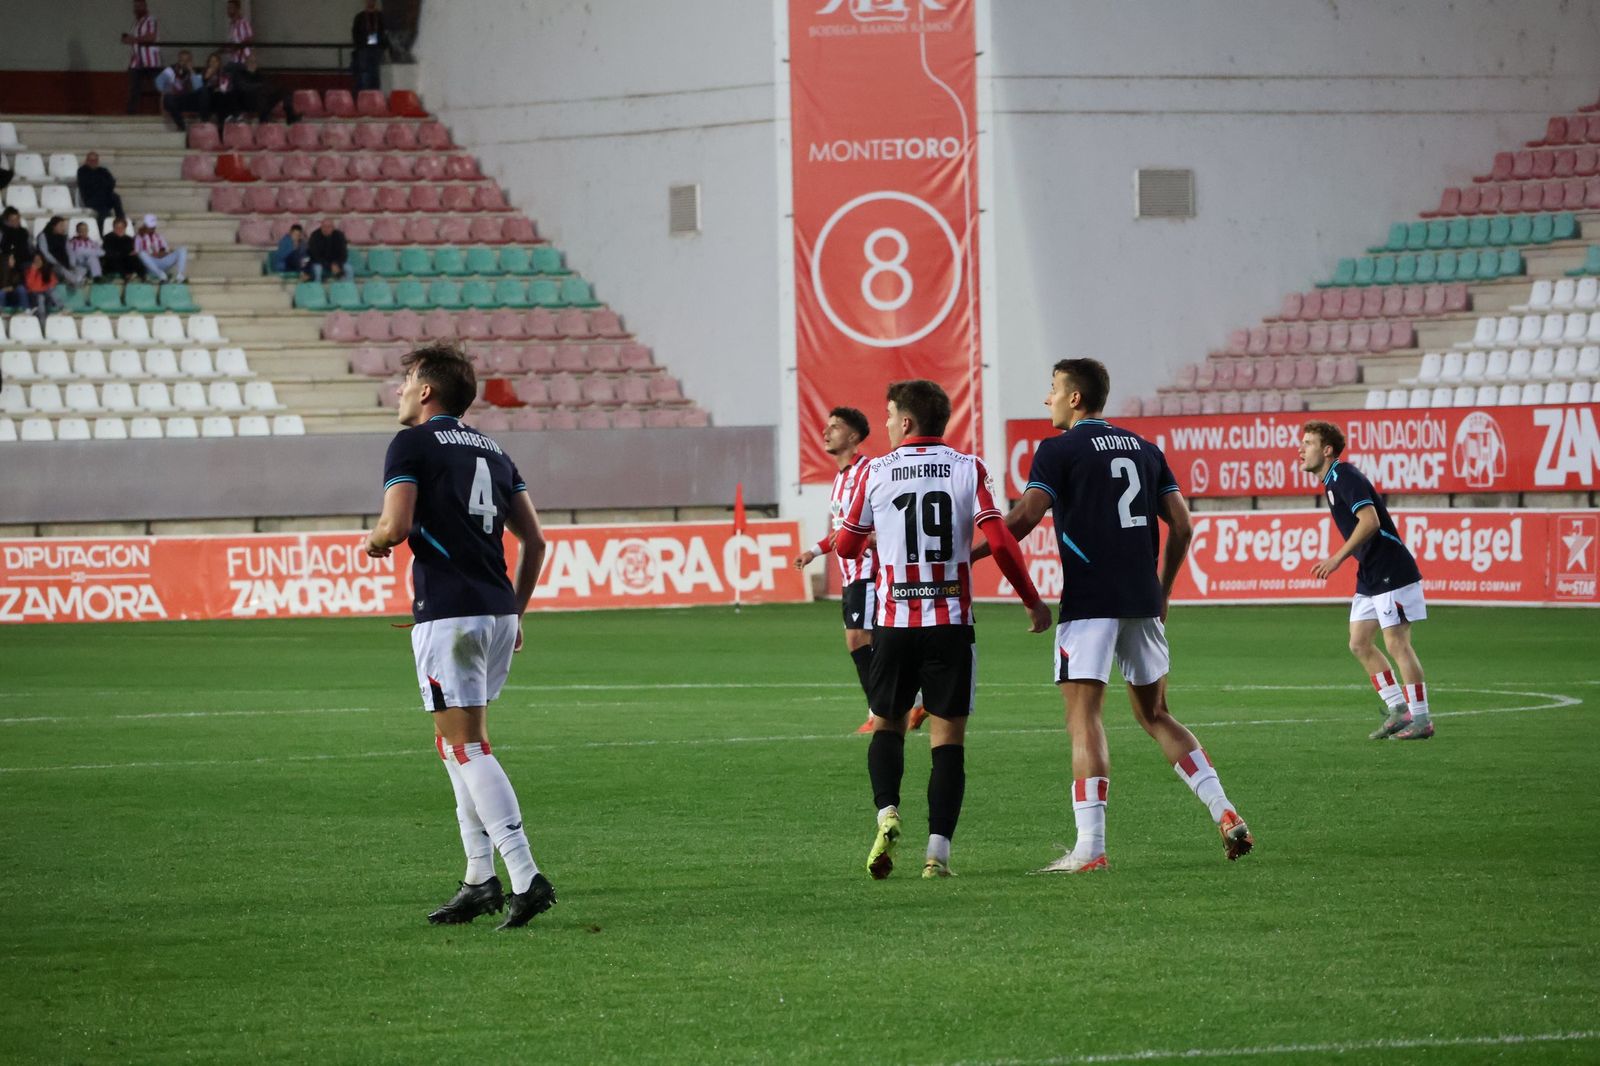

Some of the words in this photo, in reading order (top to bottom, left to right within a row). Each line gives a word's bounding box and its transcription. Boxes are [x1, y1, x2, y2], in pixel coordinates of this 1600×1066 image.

[809, 136, 960, 162] MONTETORO
[861, 227, 913, 312] 8
[1091, 435, 1141, 452] IRURITA
[1347, 413, 1447, 450] FUNDACIÓN
[468, 456, 498, 535] 4
[891, 463, 951, 482] MONERRIS
[1110, 457, 1148, 529] 2
[1219, 461, 1250, 490] 675
[1254, 460, 1285, 489] 630
[892, 490, 953, 563] 19
[1214, 517, 1331, 571] Freigel
[1404, 516, 1523, 573] Freigel
[723, 532, 792, 592] CF
[0, 584, 169, 622] ZAMORA
